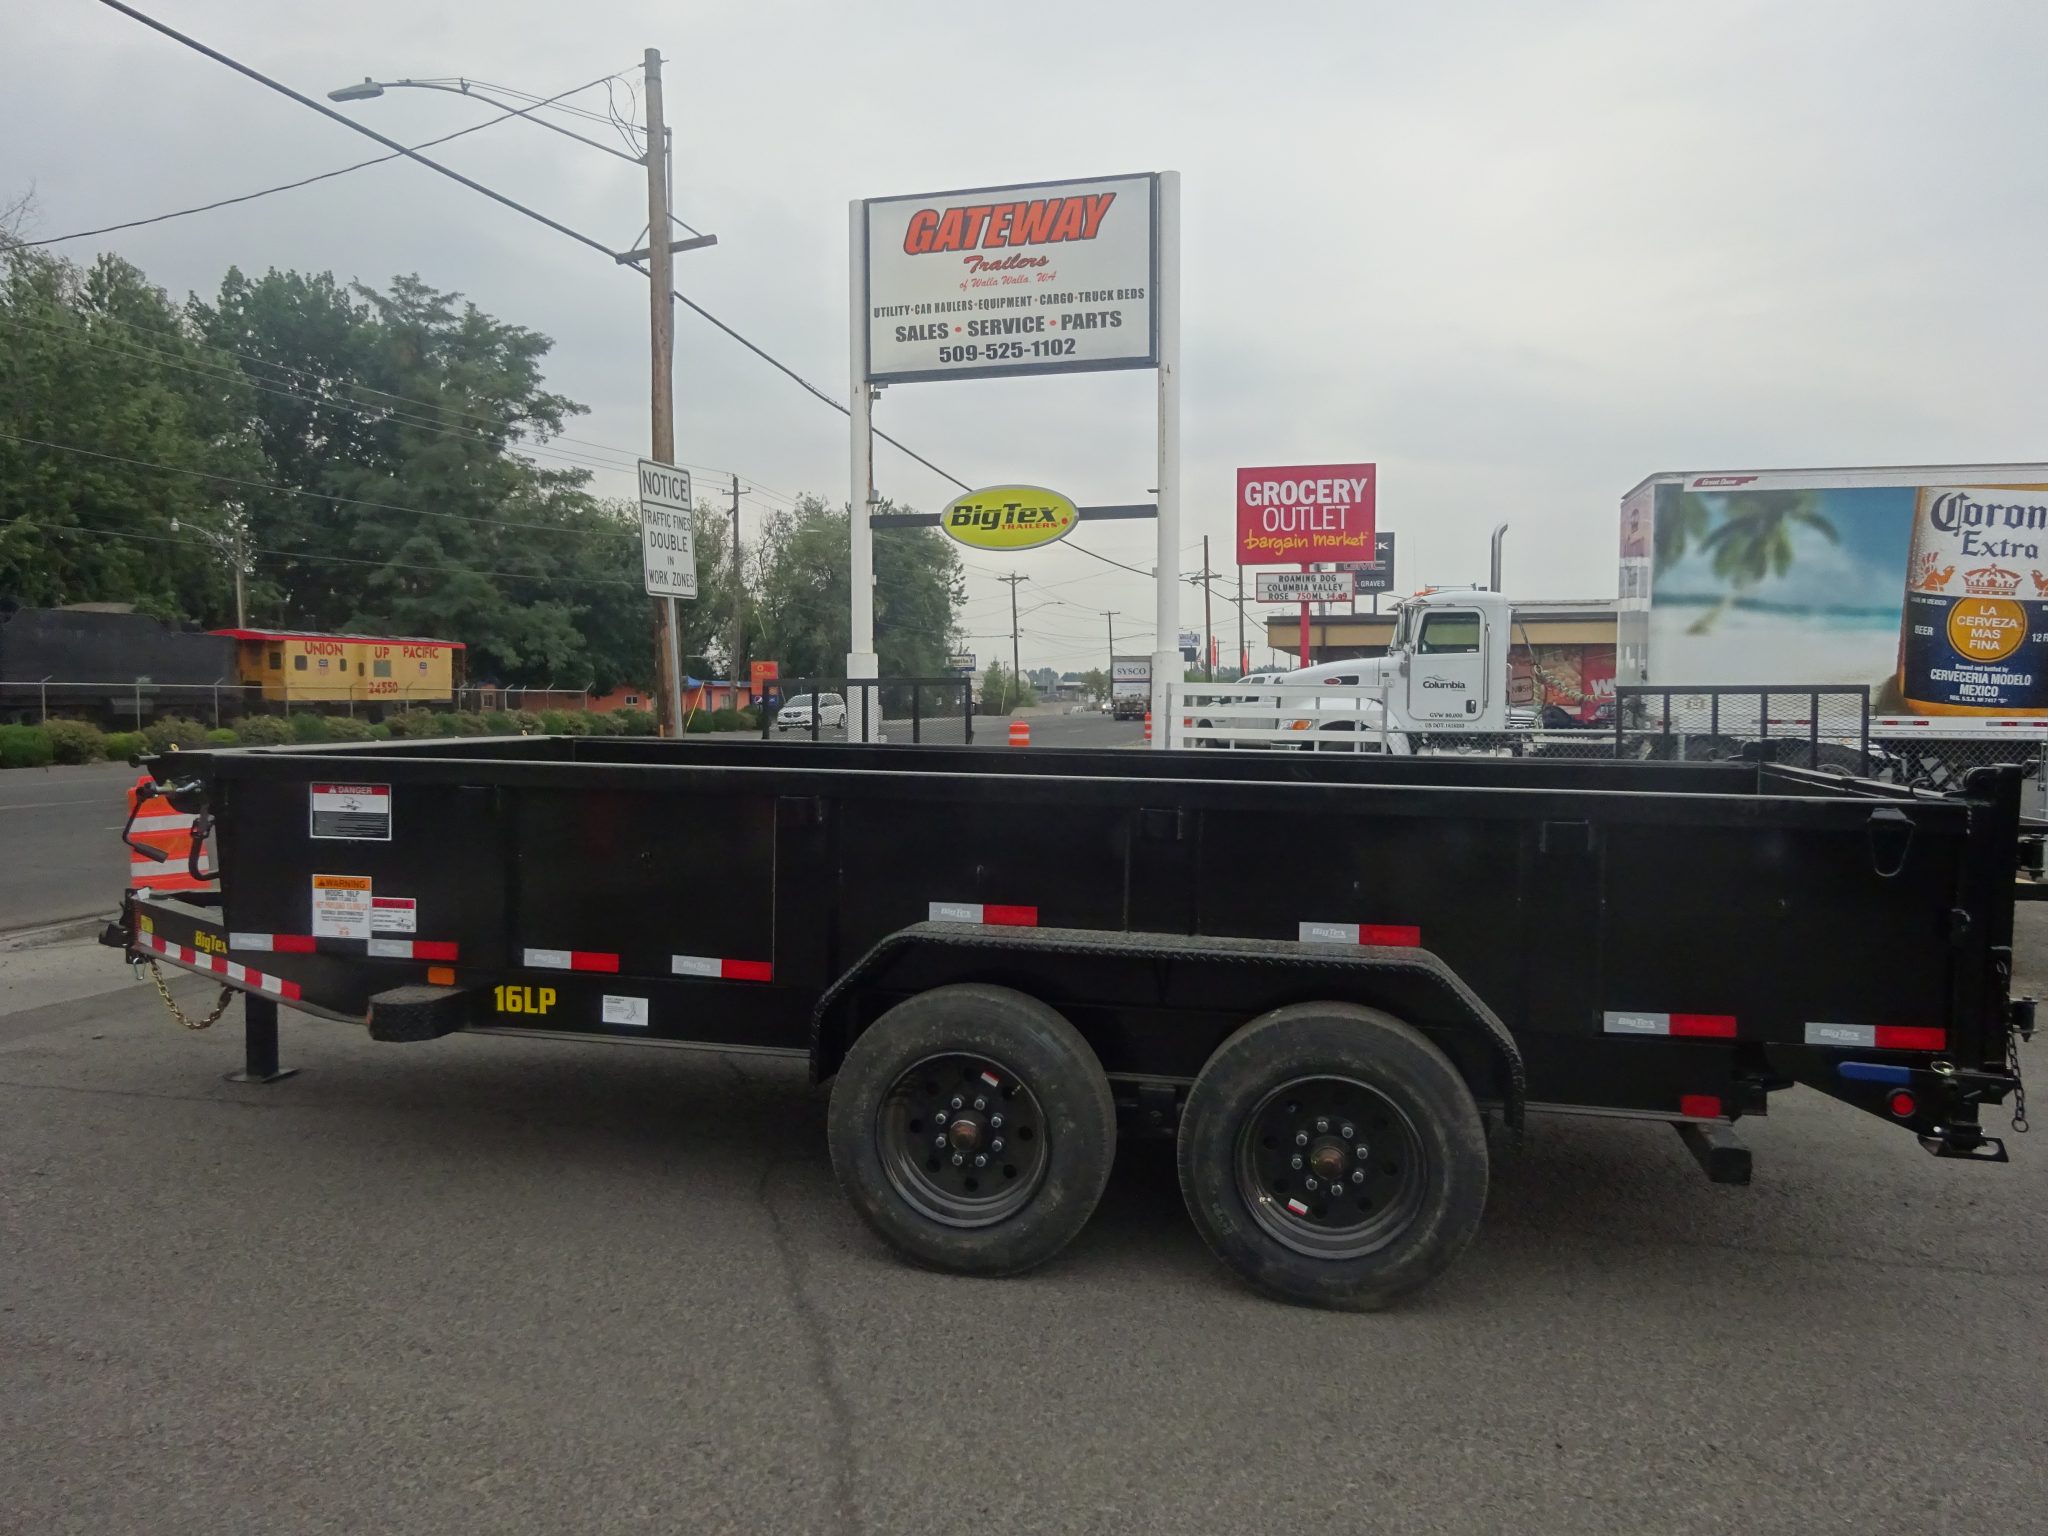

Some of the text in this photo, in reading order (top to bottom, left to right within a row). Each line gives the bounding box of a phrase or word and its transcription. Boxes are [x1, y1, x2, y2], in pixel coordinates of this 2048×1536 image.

[903, 192, 1117, 255] GATEWAY
[963, 253, 1050, 273] Trailers
[959, 280, 968, 291] of
[971, 277, 998, 288] Walla
[1036, 271, 1057, 283] WA
[873, 287, 1145, 318] UTILITY CAR HAULERS EQUIPMENT CARGO TRUCK BEDS
[895, 310, 1122, 343] SALES SERVICE PARTS
[939, 338, 1076, 363] 509-525-1102
[642, 470, 689, 502] NOTICE
[1244, 478, 1368, 506] GROCERY
[644, 508, 691, 532] TRAFFIC FINES
[951, 503, 1058, 530] BigTex
[1262, 506, 1350, 532] OUTLET
[1000, 522, 1058, 530] TRAILERS
[650, 531, 688, 553] DOUBLE
[1243, 529, 1365, 556] bargain market
[1961, 530, 2039, 559] Extra
[667, 555, 675, 566] IN
[648, 569, 694, 588] WORK ZONES
[1267, 583, 1343, 592] COLUMBIA VALLEY
[1278, 574, 1337, 583] ROAMING DOG
[1268, 592, 1289, 600] ROSE
[1297, 592, 1323, 600] 750ML
[1980, 605, 1997, 615] LA
[1914, 625, 1934, 636] BEER
[1957, 615, 2018, 628] CERVEZA
[1971, 628, 2001, 639] MAS
[2032, 633, 2041, 643] 12
[304, 641, 440, 659] UNION UP PACIFIC
[1969, 639, 2000, 650] FINA
[1117, 667, 1147, 675] SYSCO
[1930, 668, 2032, 686] CERVECERIA MODELO
[1423, 681, 1466, 689] Columbia
[1960, 683, 1999, 697] MEXICO
[338, 786, 372, 794] DANGER
[325, 879, 366, 889] WARNING
[195, 930, 228, 954] BigTex
[494, 985, 557, 1014] 16LP
